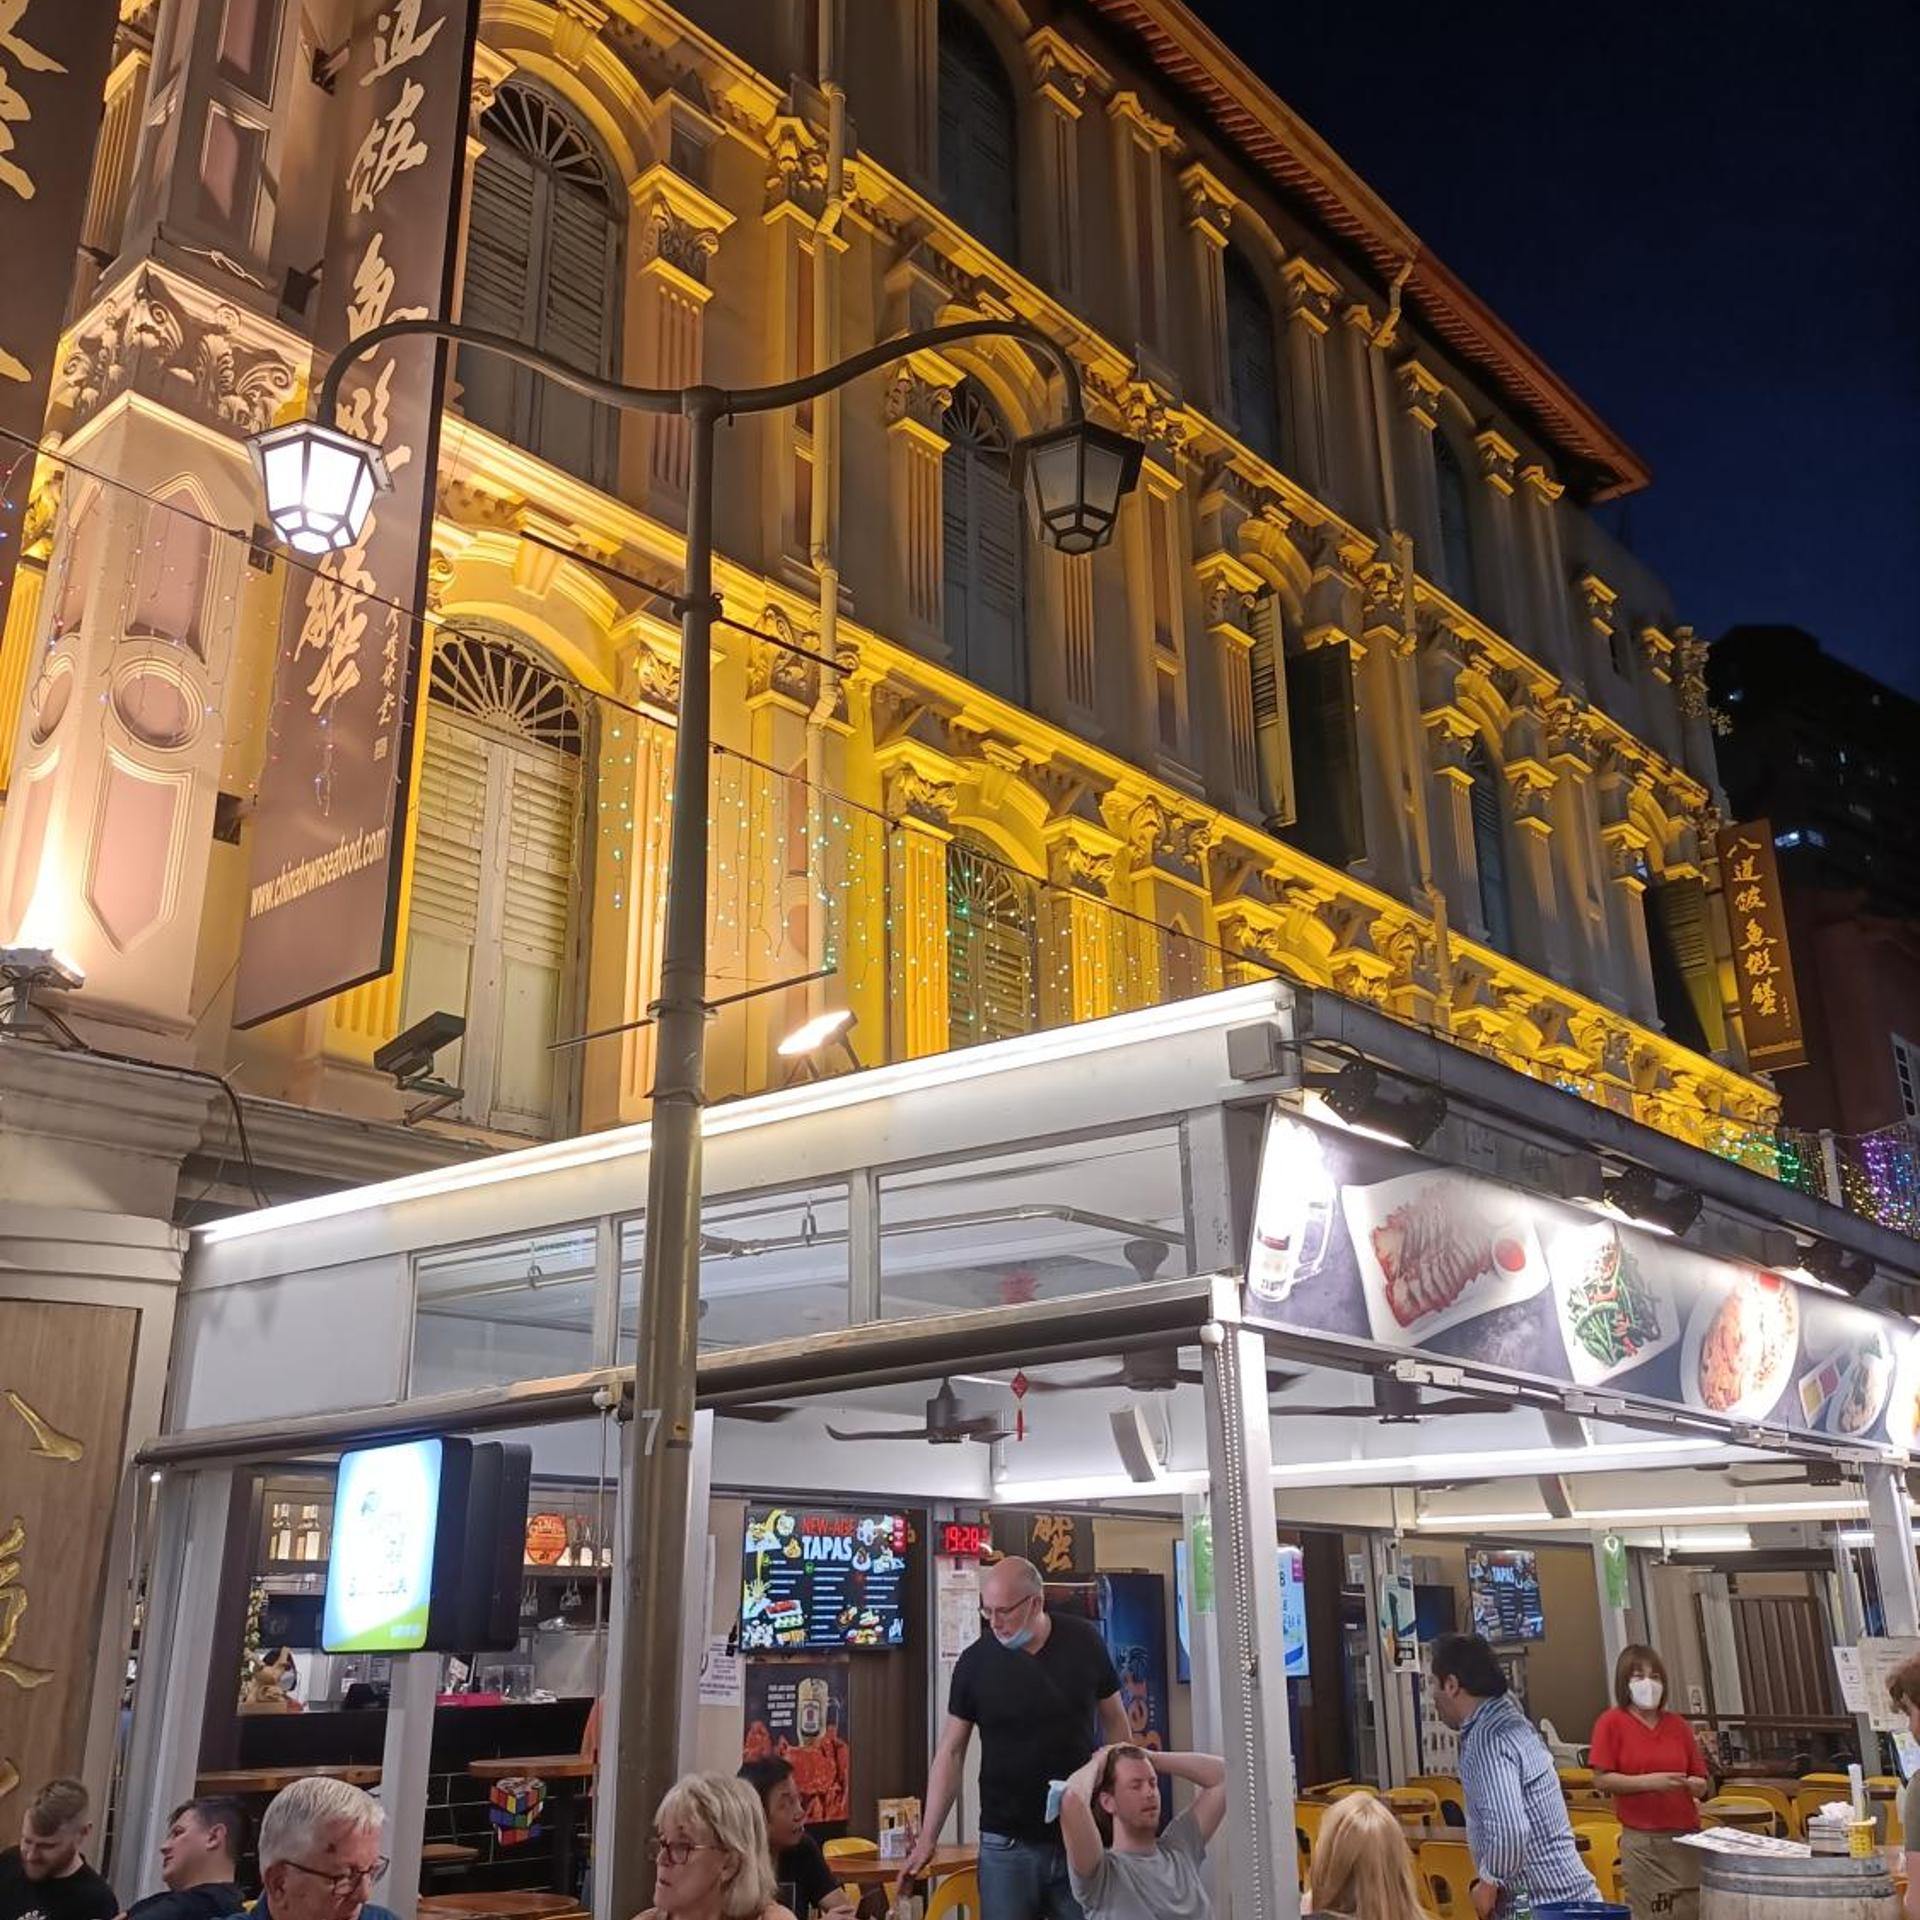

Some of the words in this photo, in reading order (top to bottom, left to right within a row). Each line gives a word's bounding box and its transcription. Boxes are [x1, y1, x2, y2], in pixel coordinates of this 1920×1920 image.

[250, 827, 387, 918] www.chinatownseafood.com
[641, 1408, 663, 1456] 7
[802, 1535, 853, 1561] TAPAS
